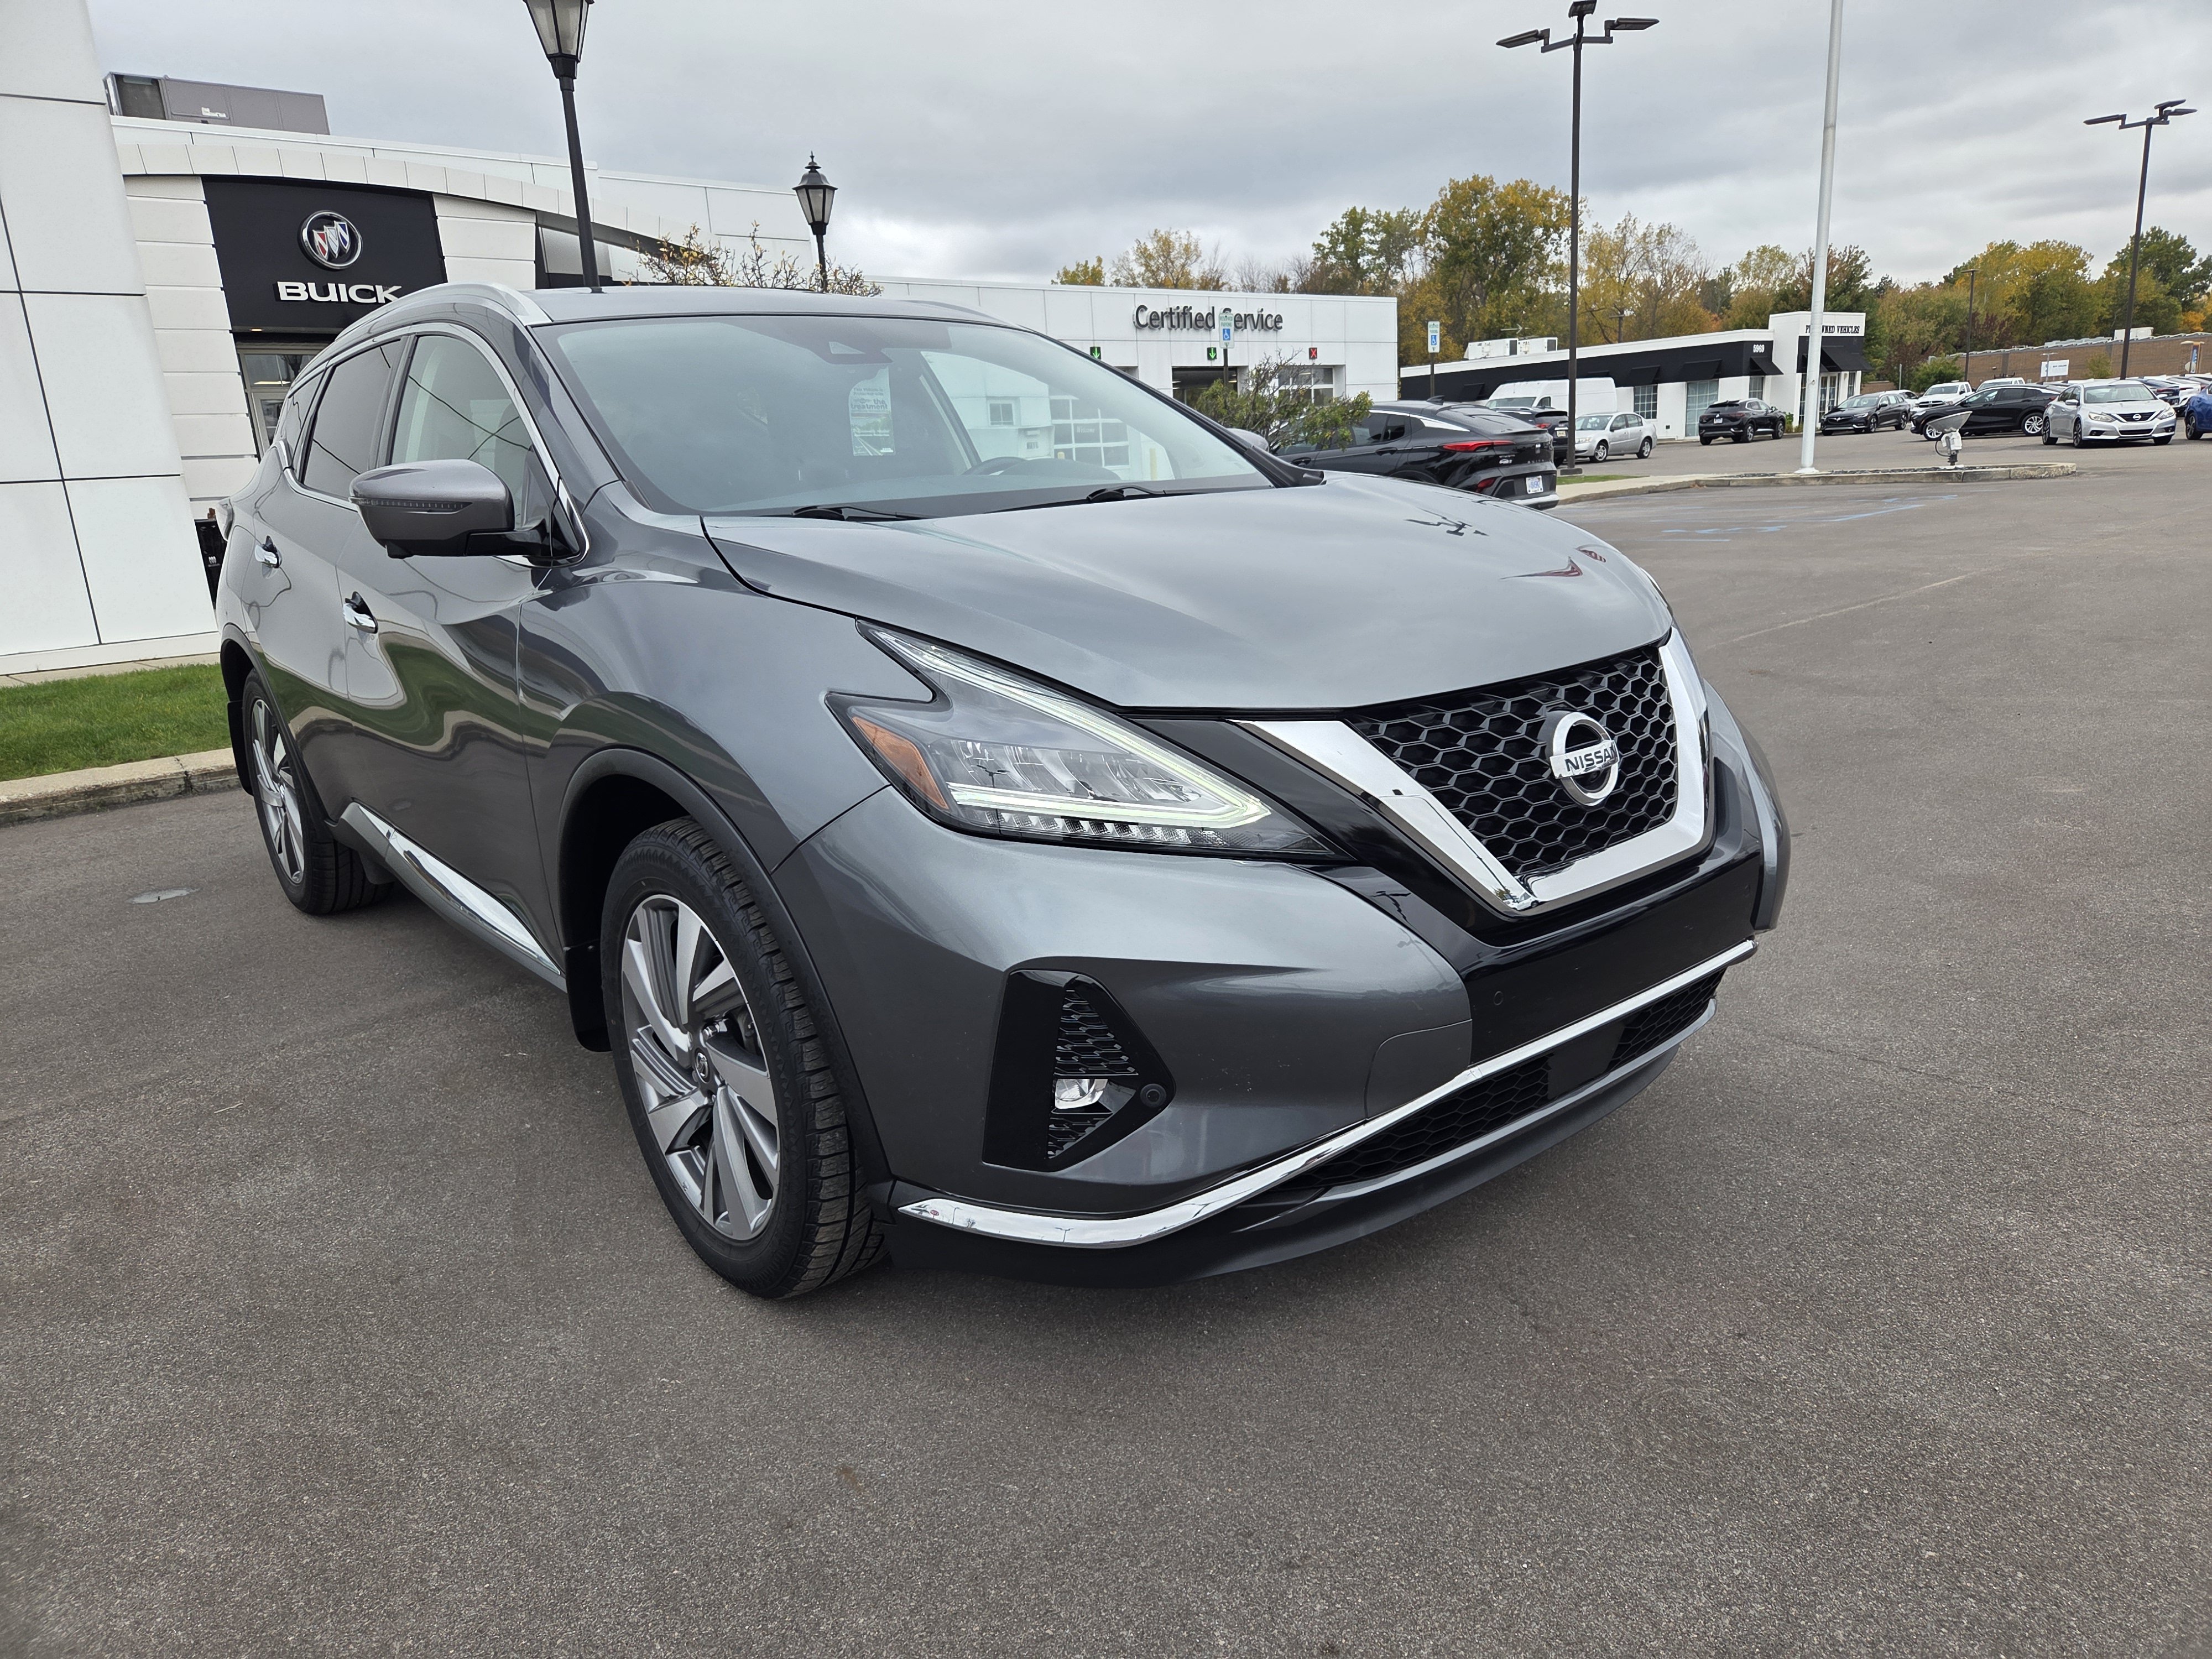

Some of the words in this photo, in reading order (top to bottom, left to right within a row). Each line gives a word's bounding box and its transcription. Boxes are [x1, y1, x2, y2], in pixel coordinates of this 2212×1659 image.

[277, 281, 402, 304] BUICK
[1135, 305, 1215, 329] Certified
[1753, 344, 1765, 353] 5969
[1564, 746, 1617, 772] NISSAN
